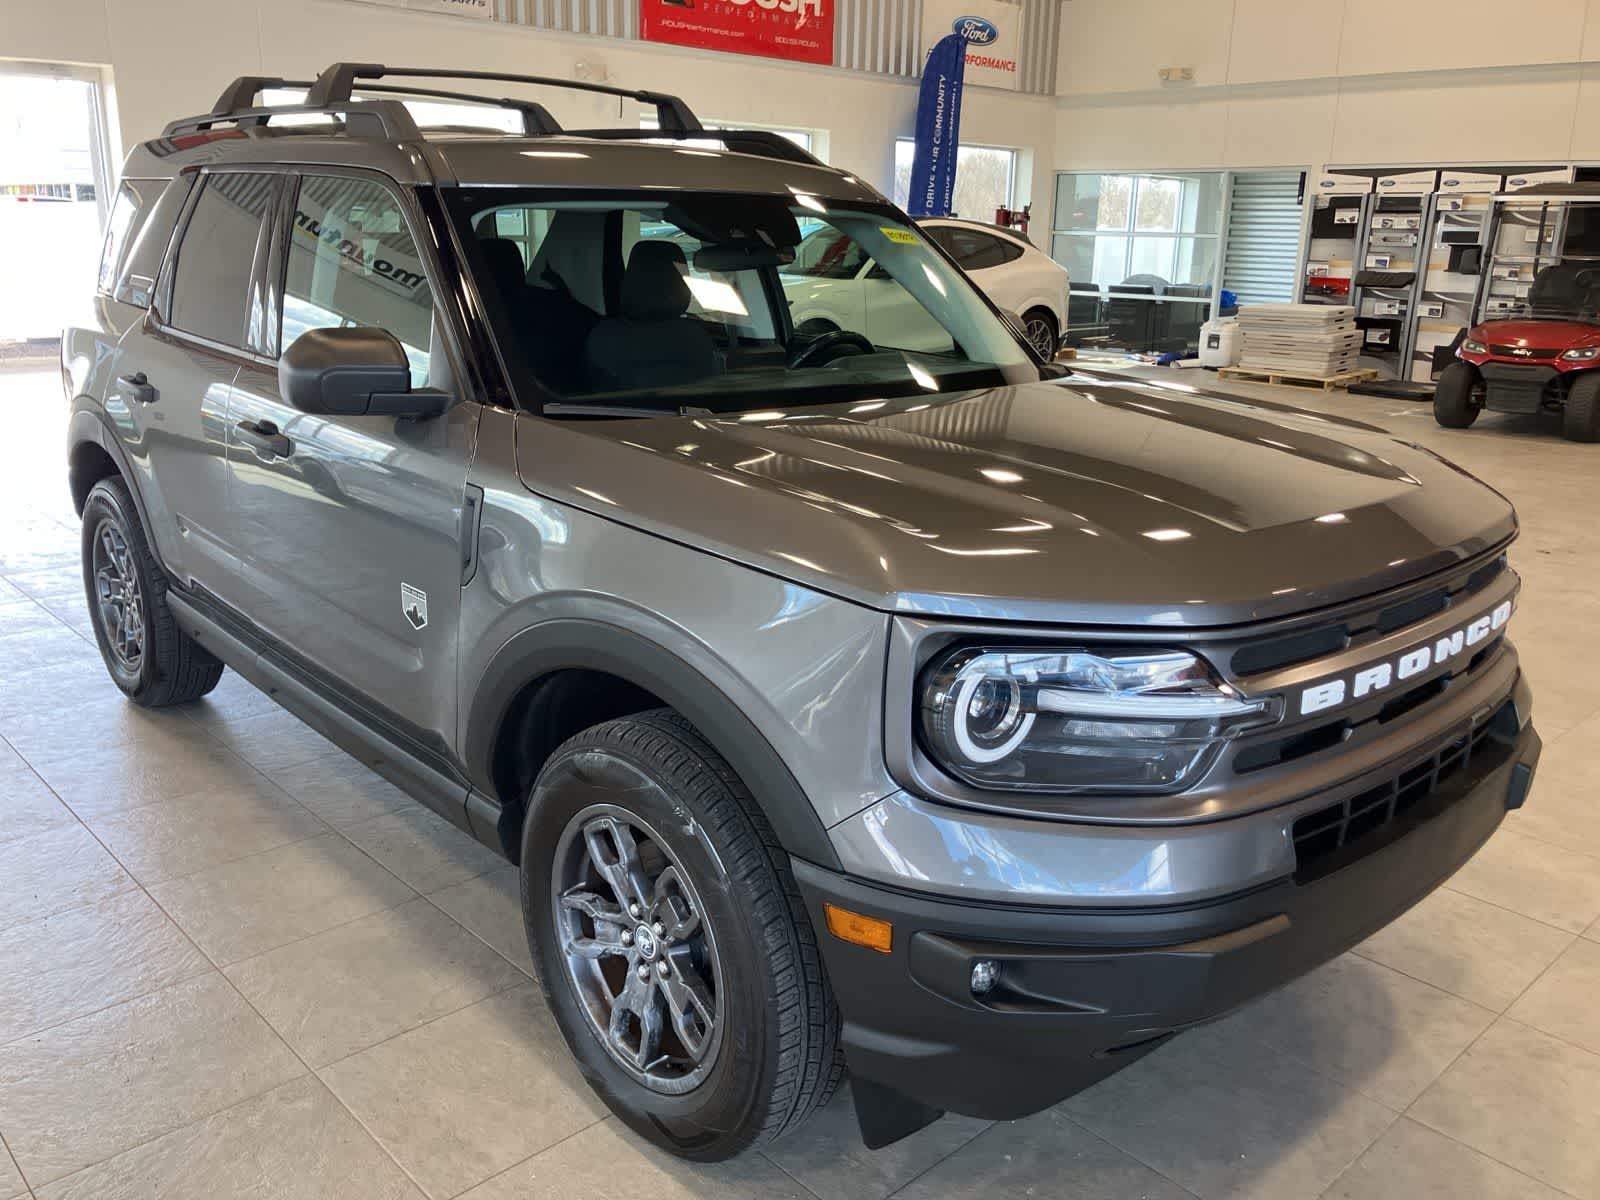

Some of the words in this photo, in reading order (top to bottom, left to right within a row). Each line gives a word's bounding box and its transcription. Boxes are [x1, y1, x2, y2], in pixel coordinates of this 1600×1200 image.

[703, 2, 823, 29] PERFORMANCE
[961, 20, 990, 42] Ford
[964, 54, 1017, 72] RFORMANCE
[926, 174, 936, 209] DRIVE
[934, 74, 946, 145] COMMUNITY
[1300, 600, 1512, 716] BRONCO
